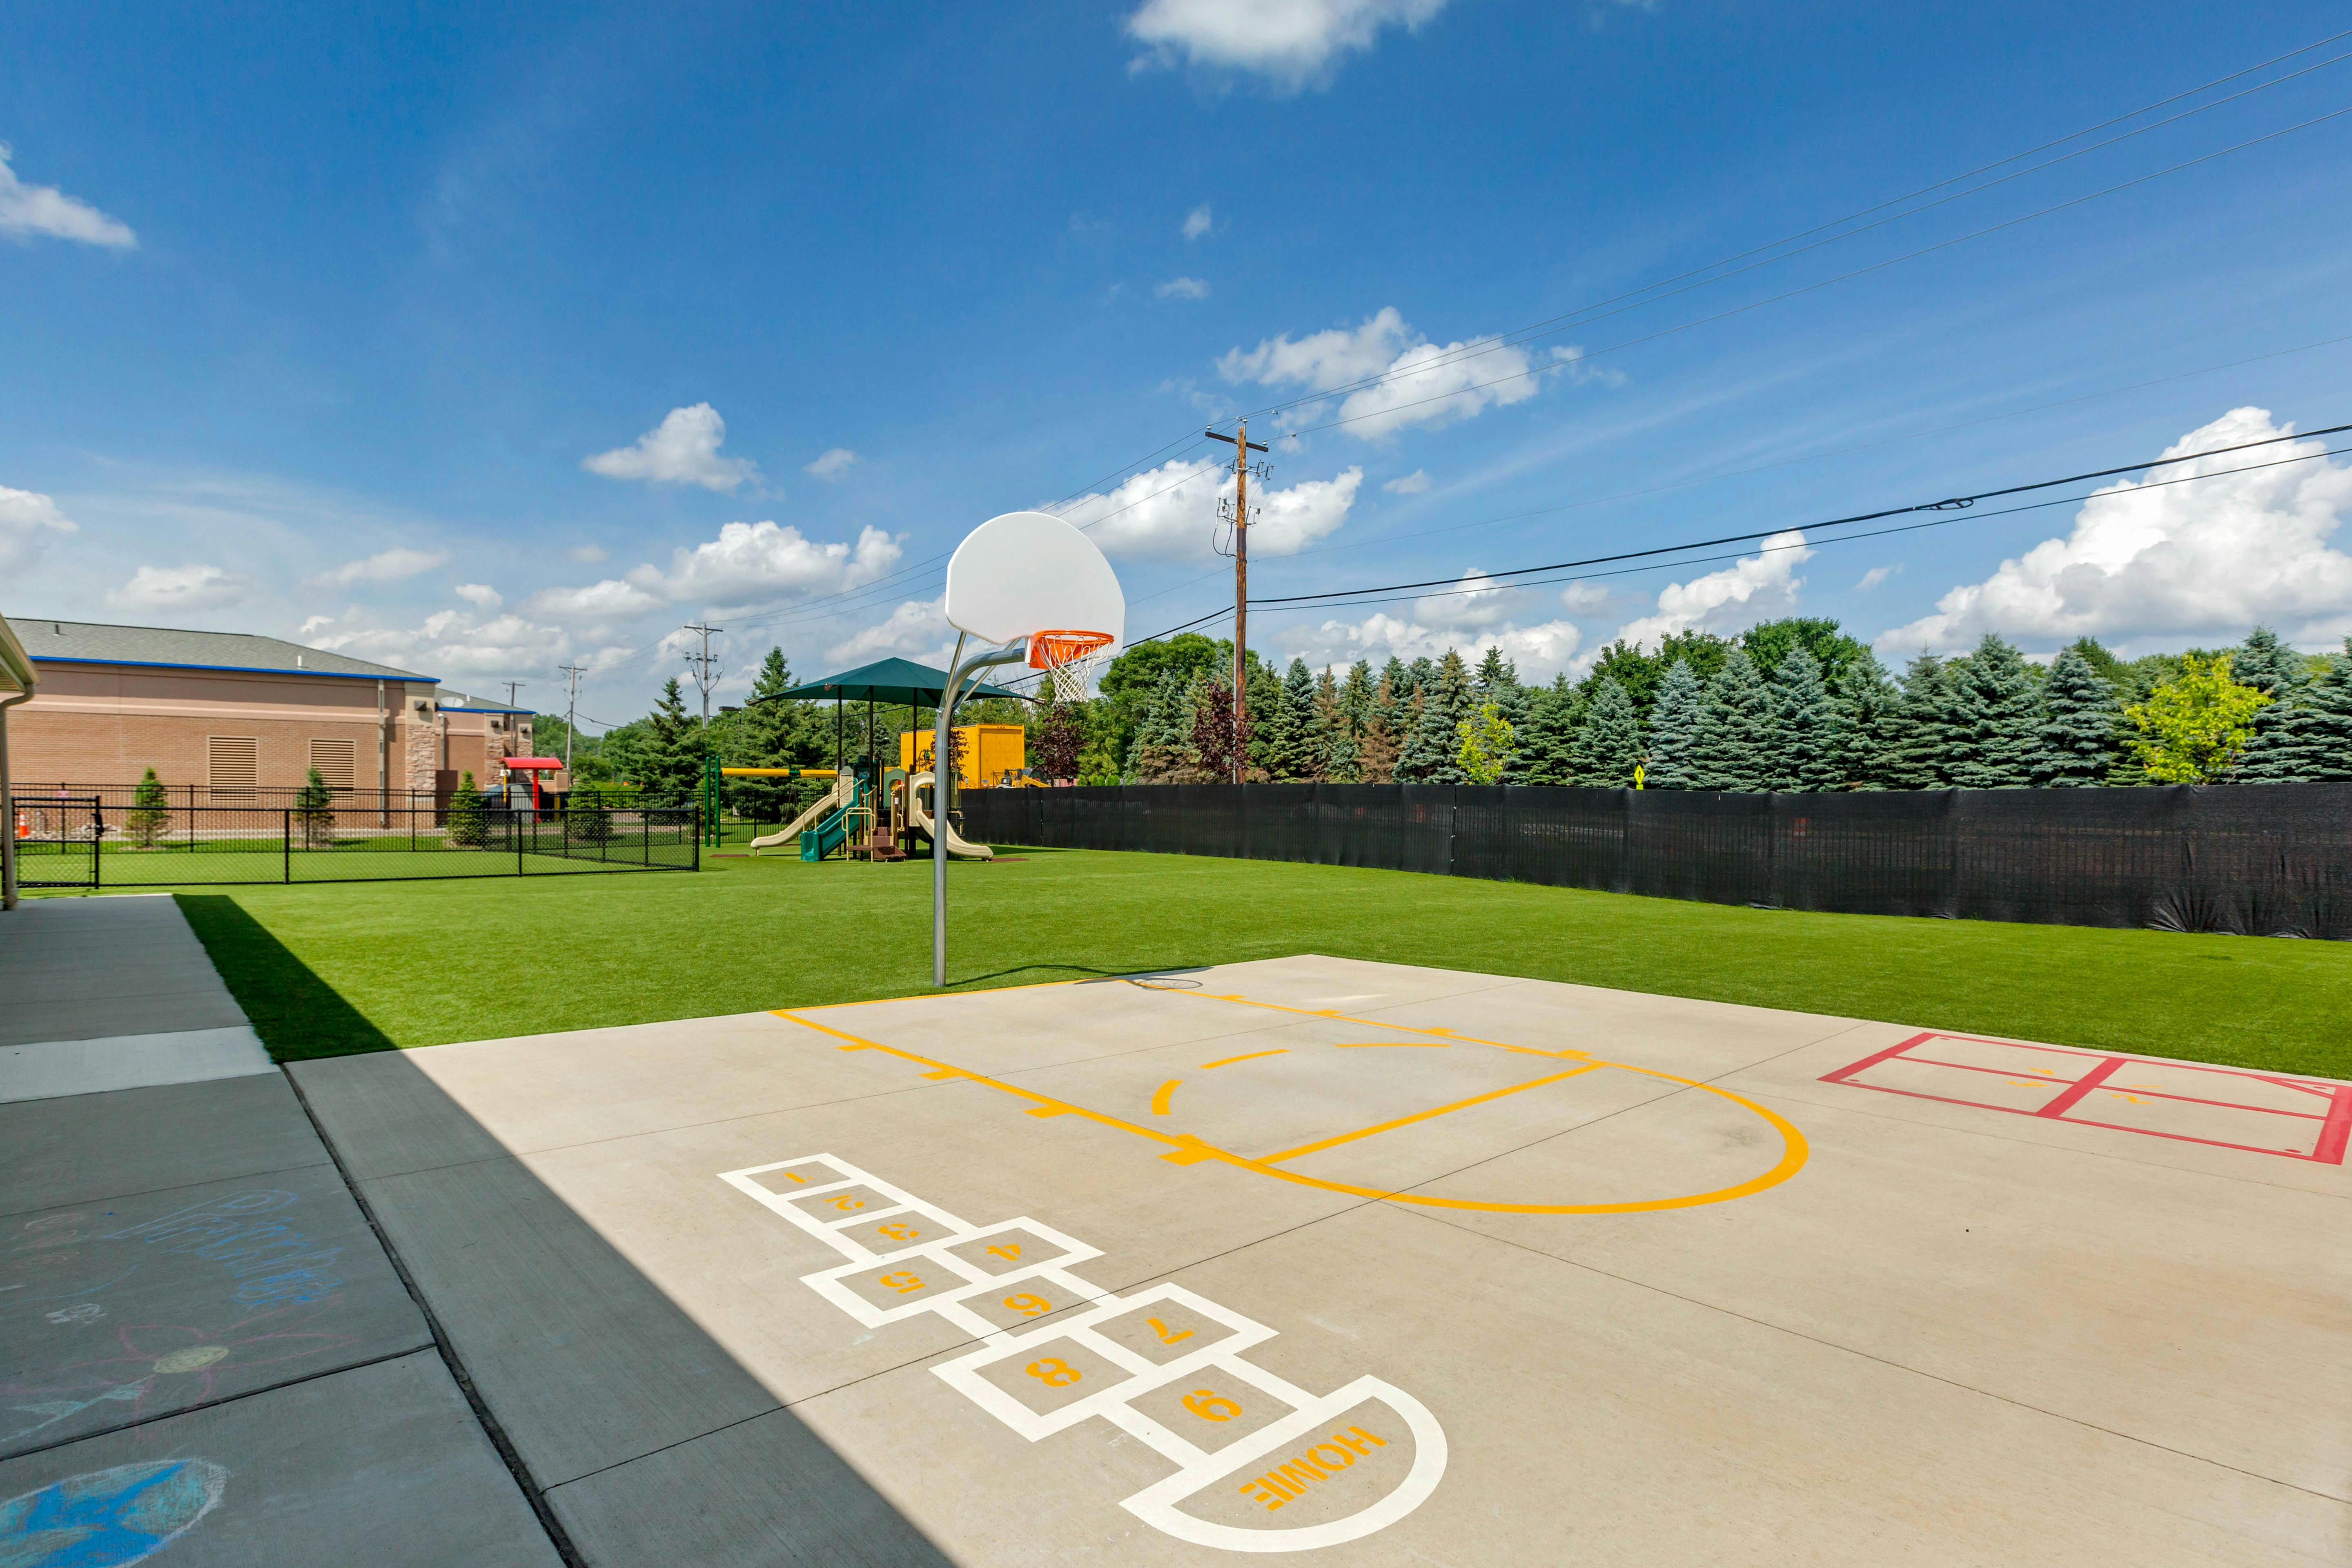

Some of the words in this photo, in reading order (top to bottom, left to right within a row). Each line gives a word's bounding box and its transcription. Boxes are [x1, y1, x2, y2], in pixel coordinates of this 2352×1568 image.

[2110, 1094, 2153, 1105] 2
[825, 1195, 865, 1211] 2
[878, 1223, 920, 1241] 3
[987, 1243, 1022, 1262] 4
[880, 1271, 926, 1294] 5
[1003, 1293, 1052, 1317] 6
[1146, 1317, 1195, 1345] 7
[1025, 1358, 1082, 1388] 8
[1182, 1390, 1243, 1422] 9
[1238, 1425, 1388, 1512] HOME
